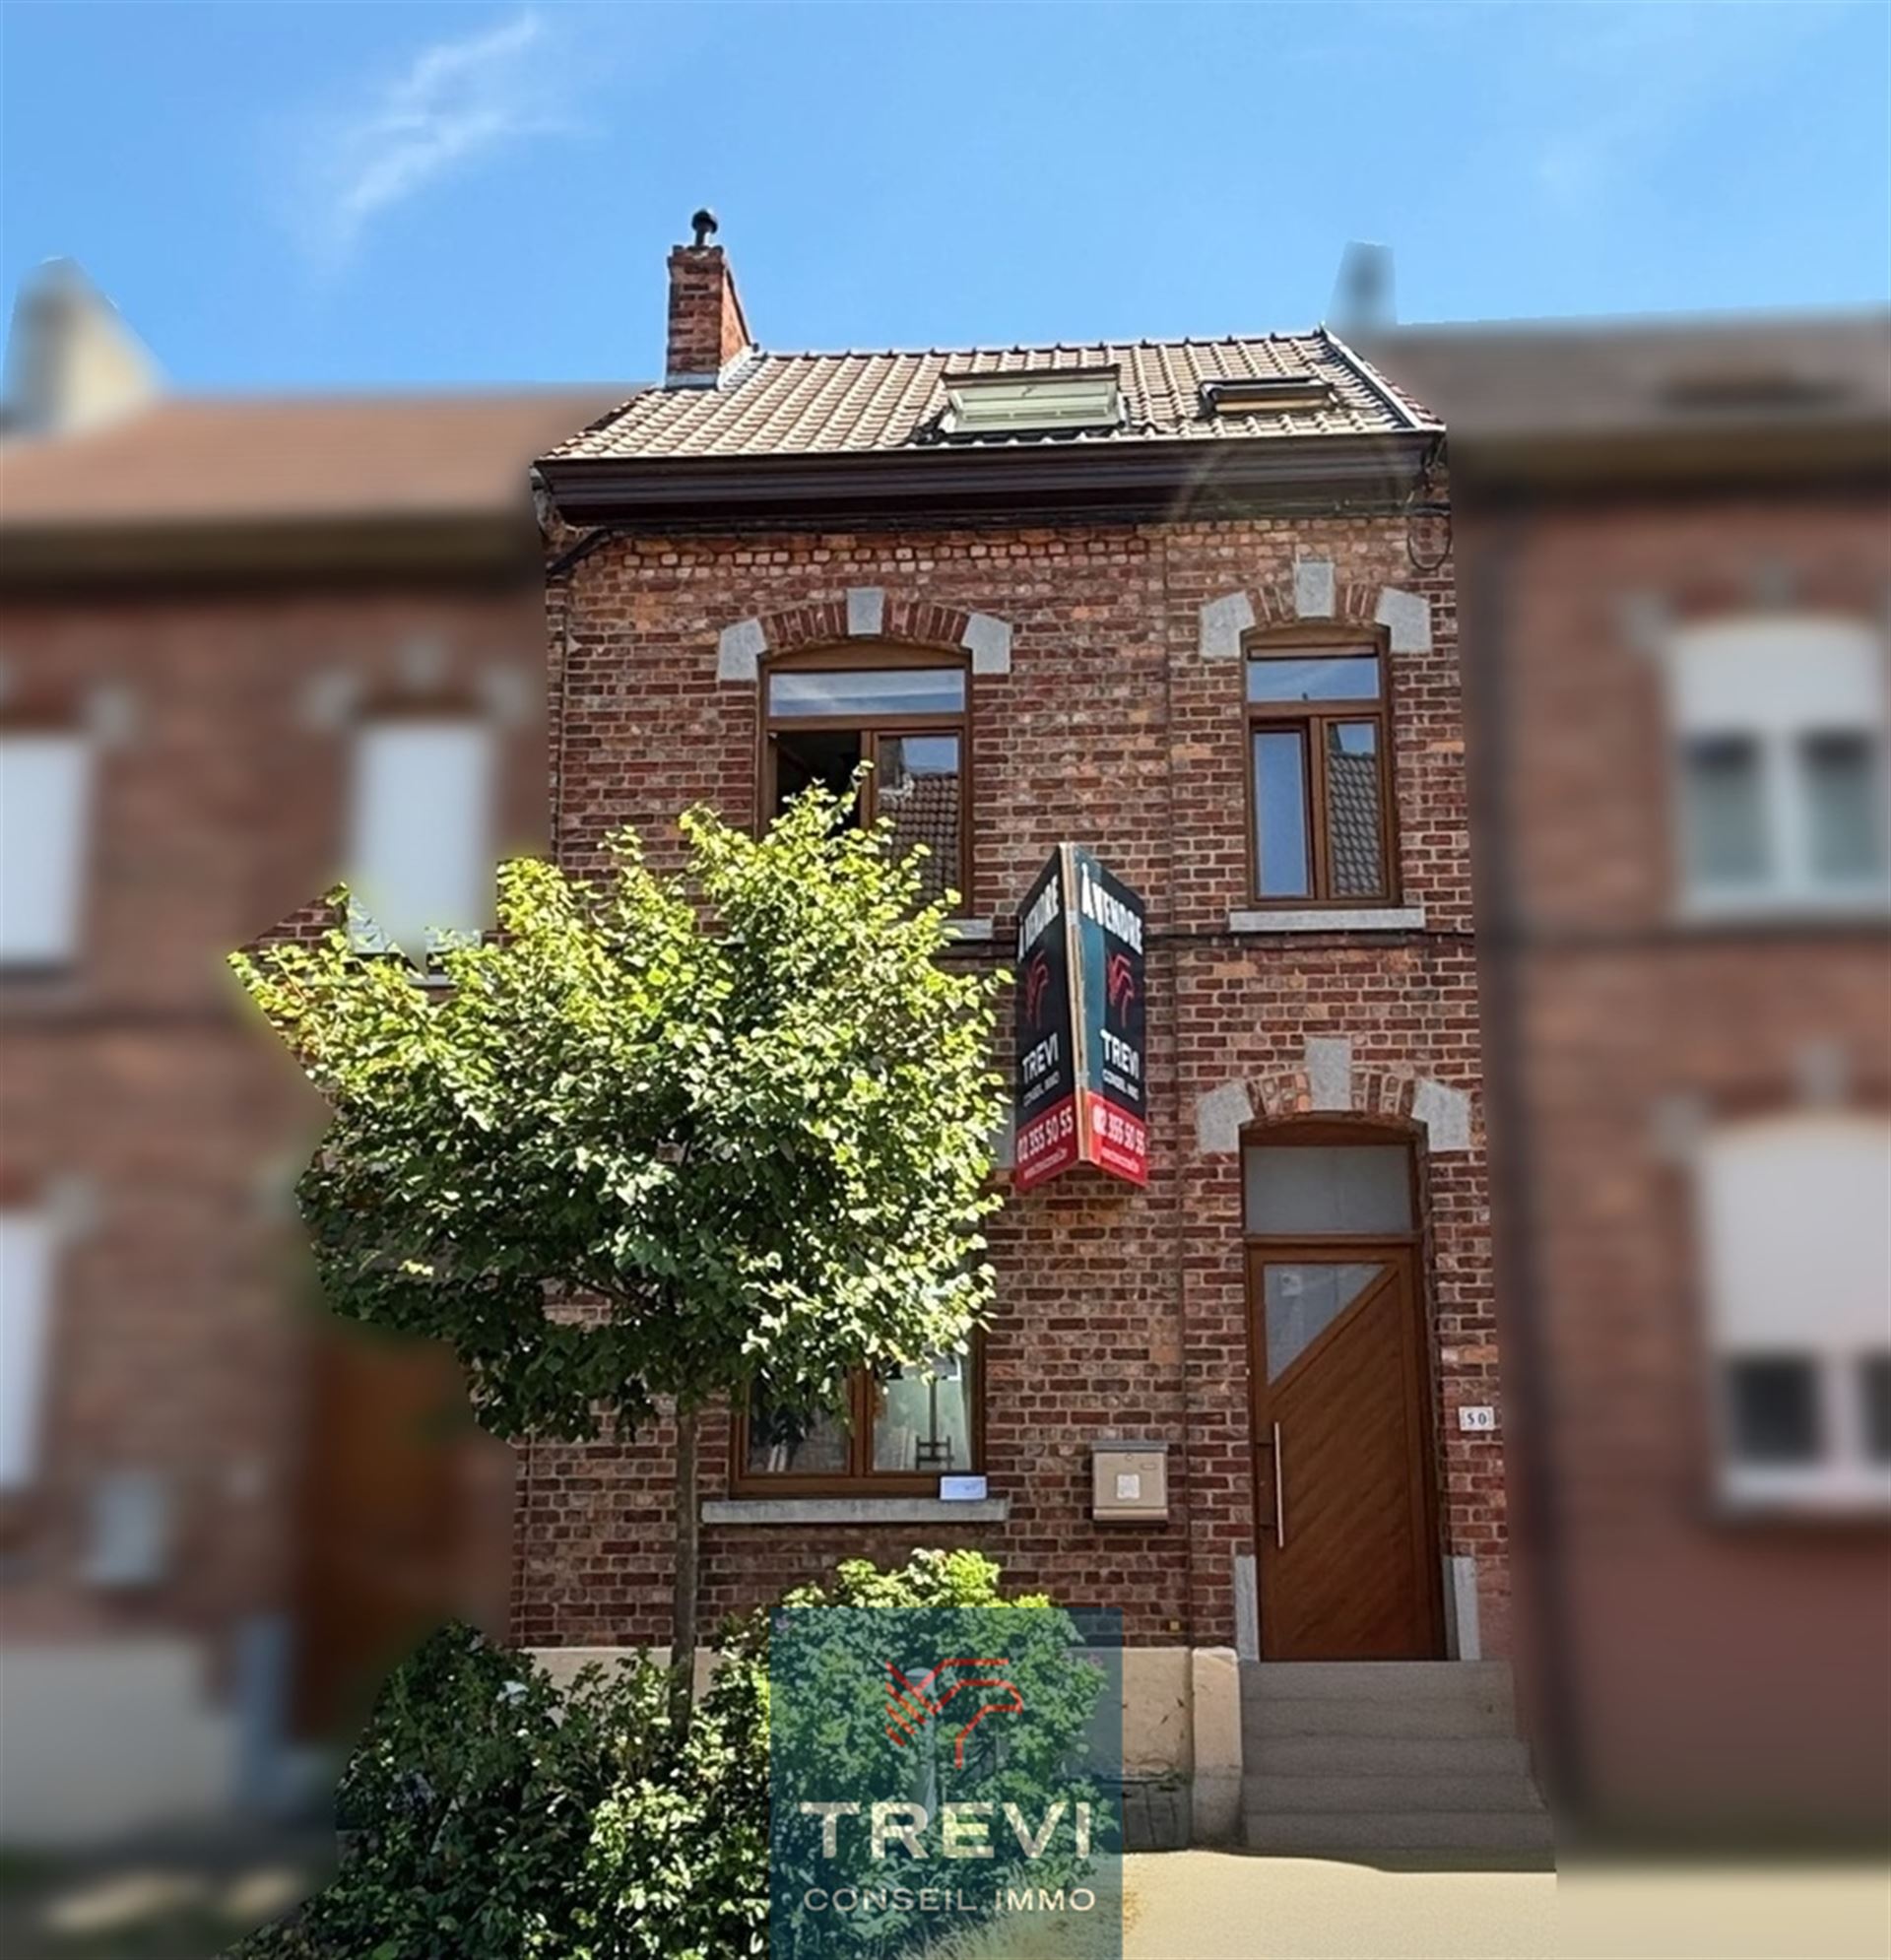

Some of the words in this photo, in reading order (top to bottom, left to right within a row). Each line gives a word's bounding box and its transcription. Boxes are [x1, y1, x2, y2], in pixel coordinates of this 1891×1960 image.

[1021, 1032, 1058, 1084] TREVI
[1100, 1028, 1140, 1080] TREVI
[1060, 1105, 1074, 1138] 55
[1467, 1411, 1487, 1425] 50
